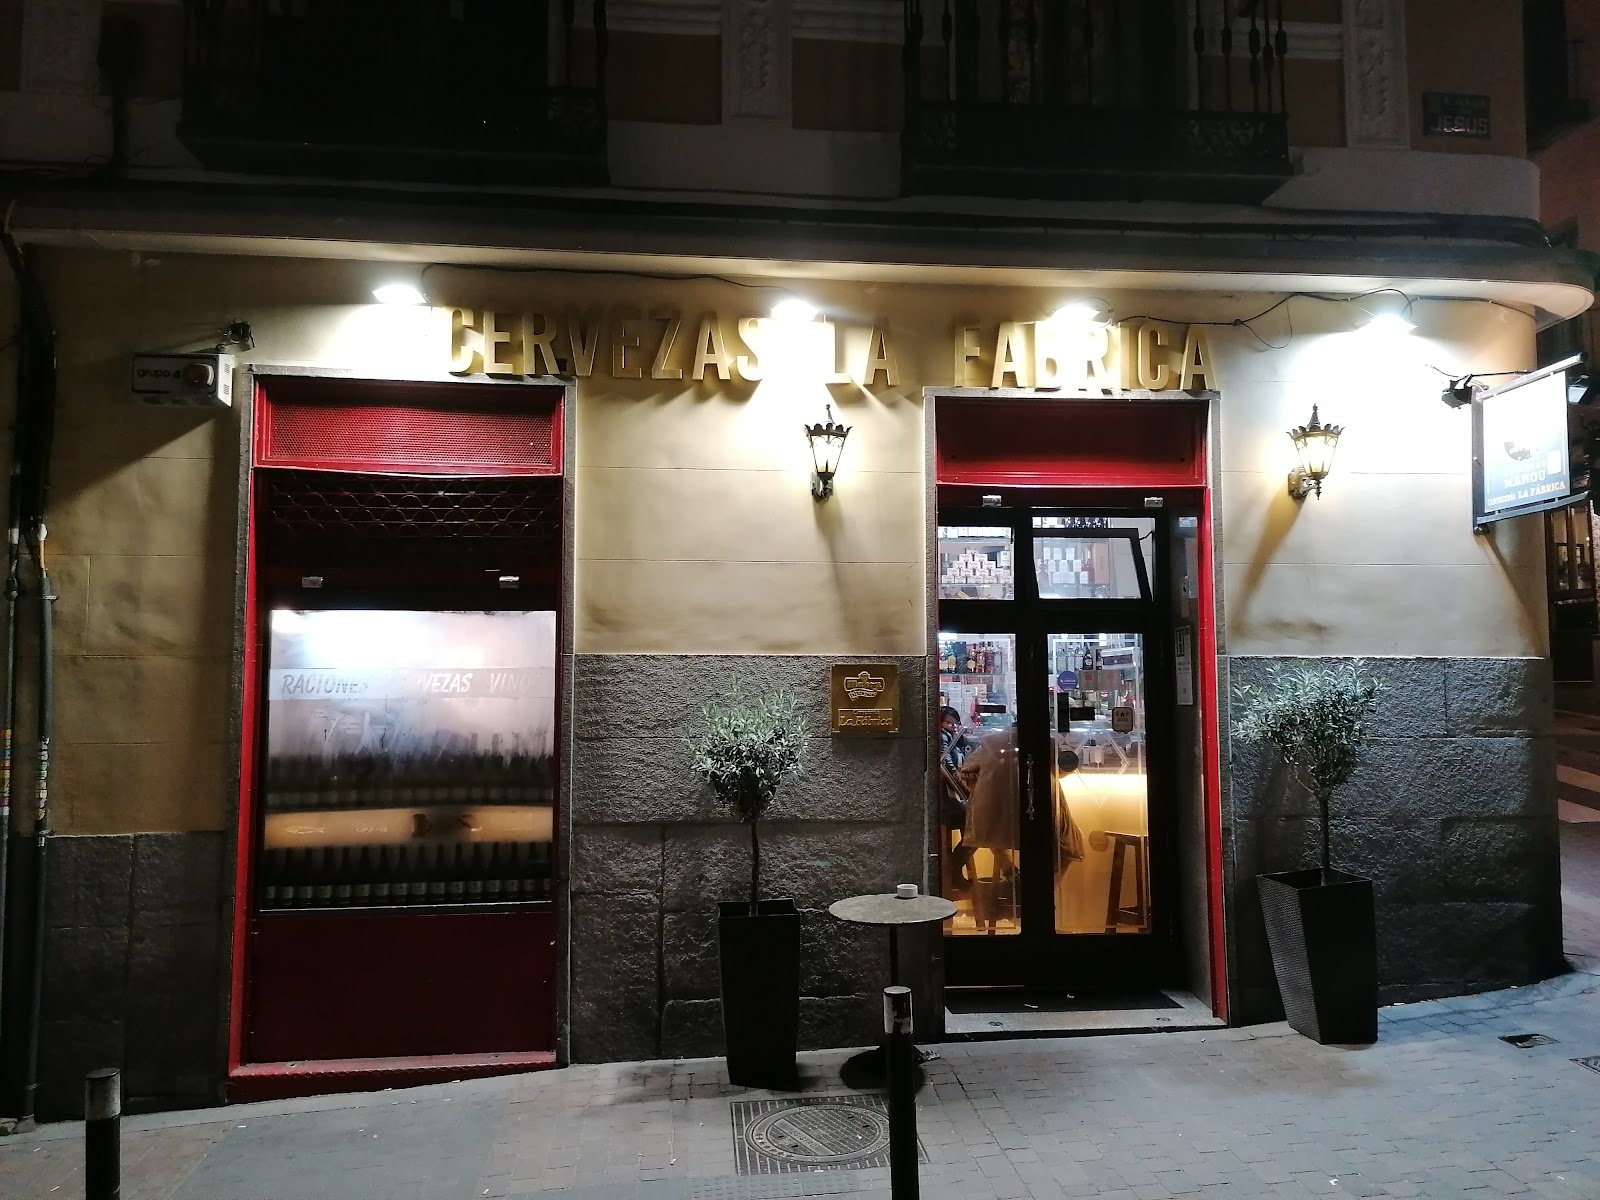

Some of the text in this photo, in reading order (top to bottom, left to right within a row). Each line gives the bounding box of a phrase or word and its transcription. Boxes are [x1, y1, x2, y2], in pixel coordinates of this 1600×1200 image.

[447, 305, 1218, 391] CERVEZAS LA FABRICA
[137, 369, 171, 379] grupo
[1504, 469, 1546, 489] MAHOU
[1518, 489, 1529, 499] LA
[1530, 481, 1566, 496] FÁBRICA
